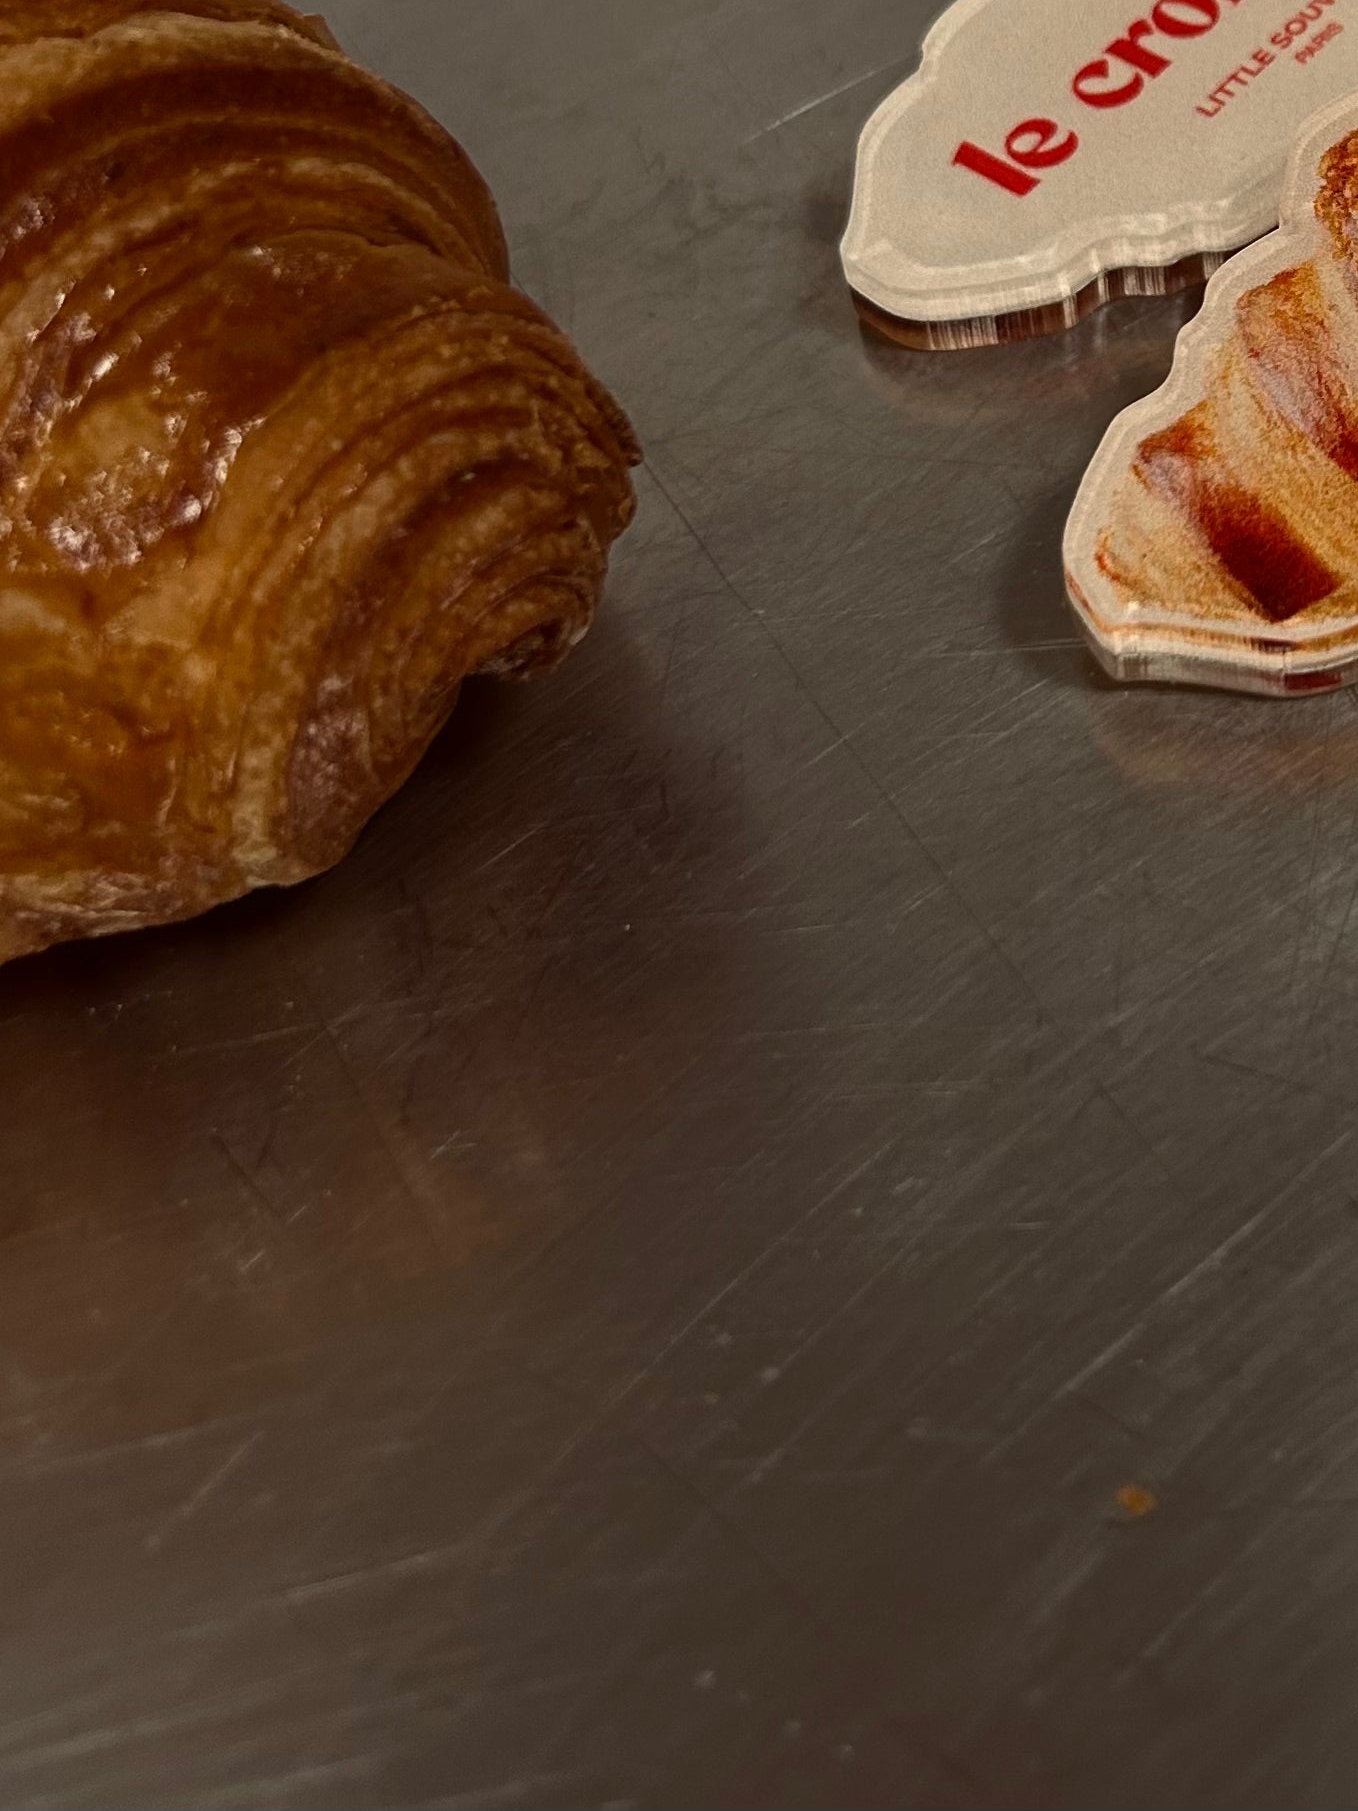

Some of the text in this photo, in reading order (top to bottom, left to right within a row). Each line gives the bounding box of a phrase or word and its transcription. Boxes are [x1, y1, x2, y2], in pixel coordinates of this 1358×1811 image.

[1294, 22, 1344, 64] PARIS
[1196, 49, 1276, 117] LITTLE
[951, 117, 1079, 198] le
